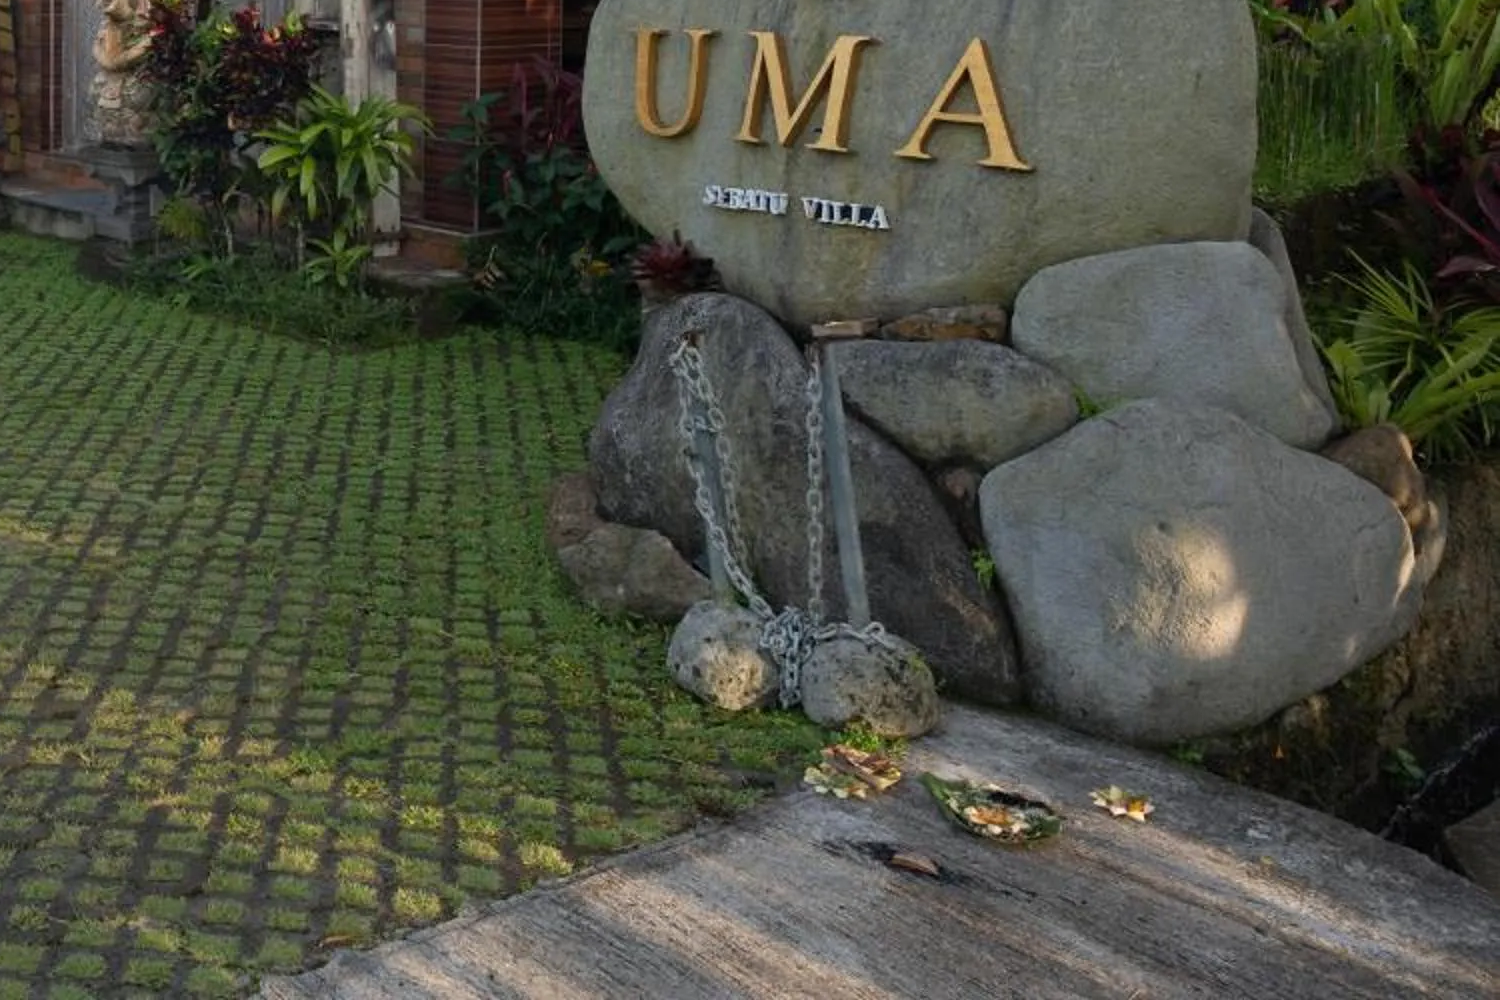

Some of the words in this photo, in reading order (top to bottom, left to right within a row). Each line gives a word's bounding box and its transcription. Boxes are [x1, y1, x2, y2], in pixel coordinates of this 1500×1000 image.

[632, 26, 1036, 173] UMA
[702, 184, 789, 215] SEBATU
[800, 196, 890, 230] VILLA
